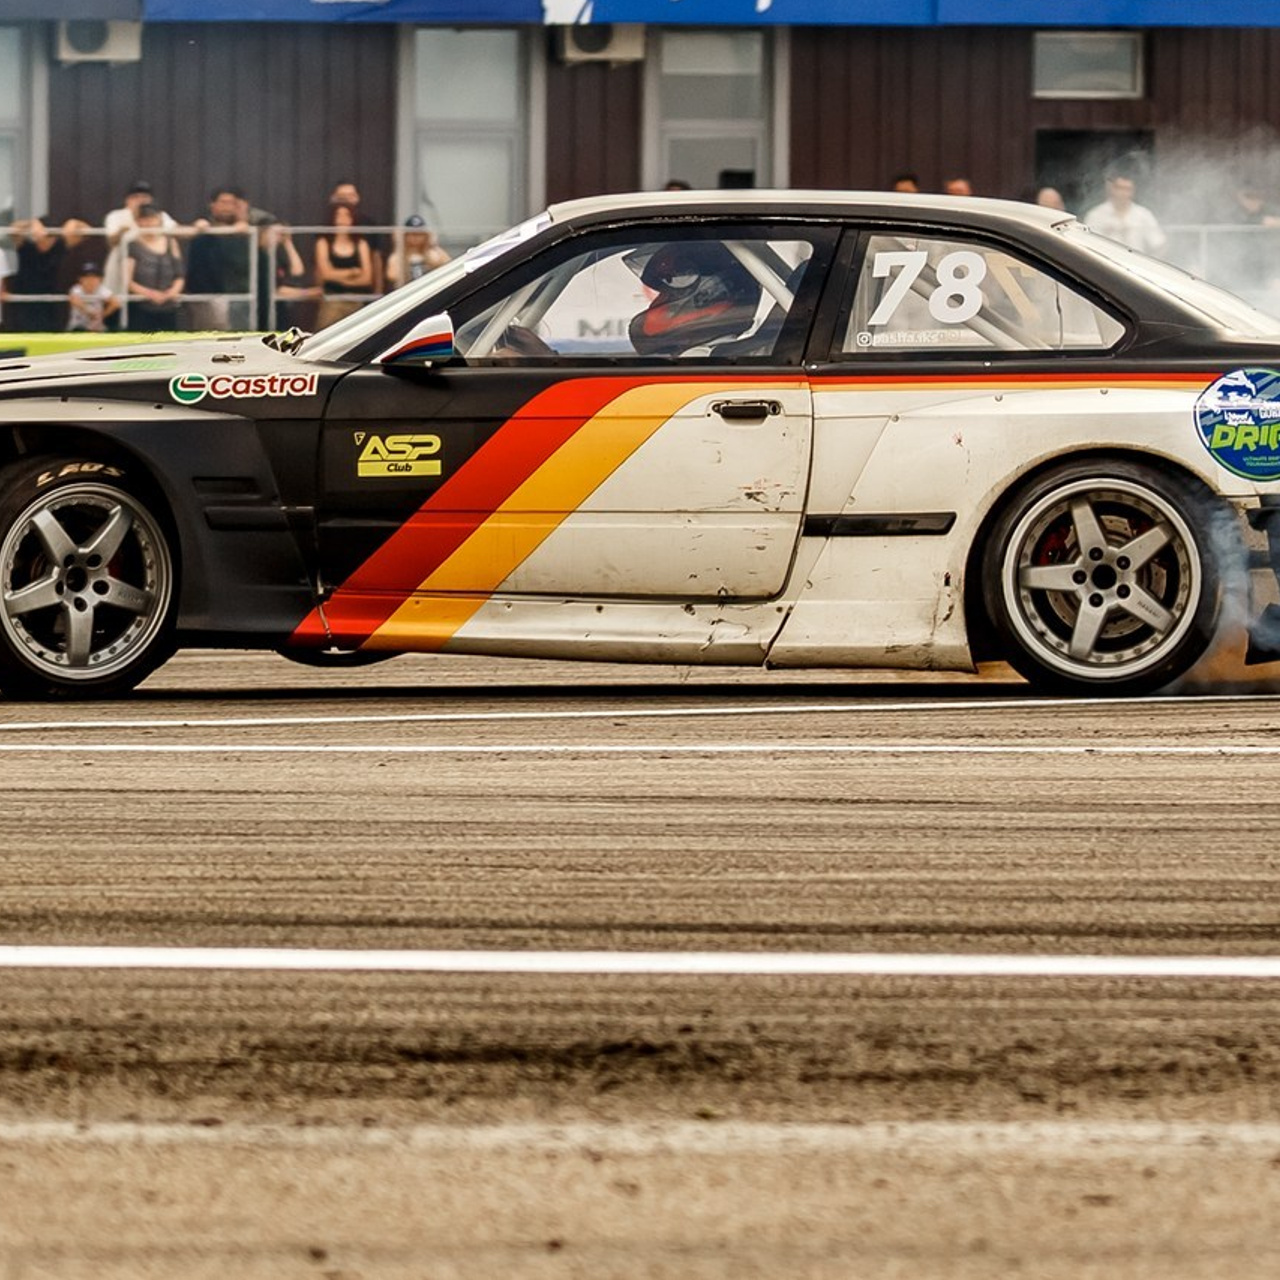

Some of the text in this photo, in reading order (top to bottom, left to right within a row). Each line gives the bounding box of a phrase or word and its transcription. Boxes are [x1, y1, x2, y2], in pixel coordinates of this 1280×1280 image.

[868, 251, 987, 324] 78
[209, 373, 316, 396] Castrol
[359, 434, 441, 460] ASP
[387, 462, 413, 473] Club
